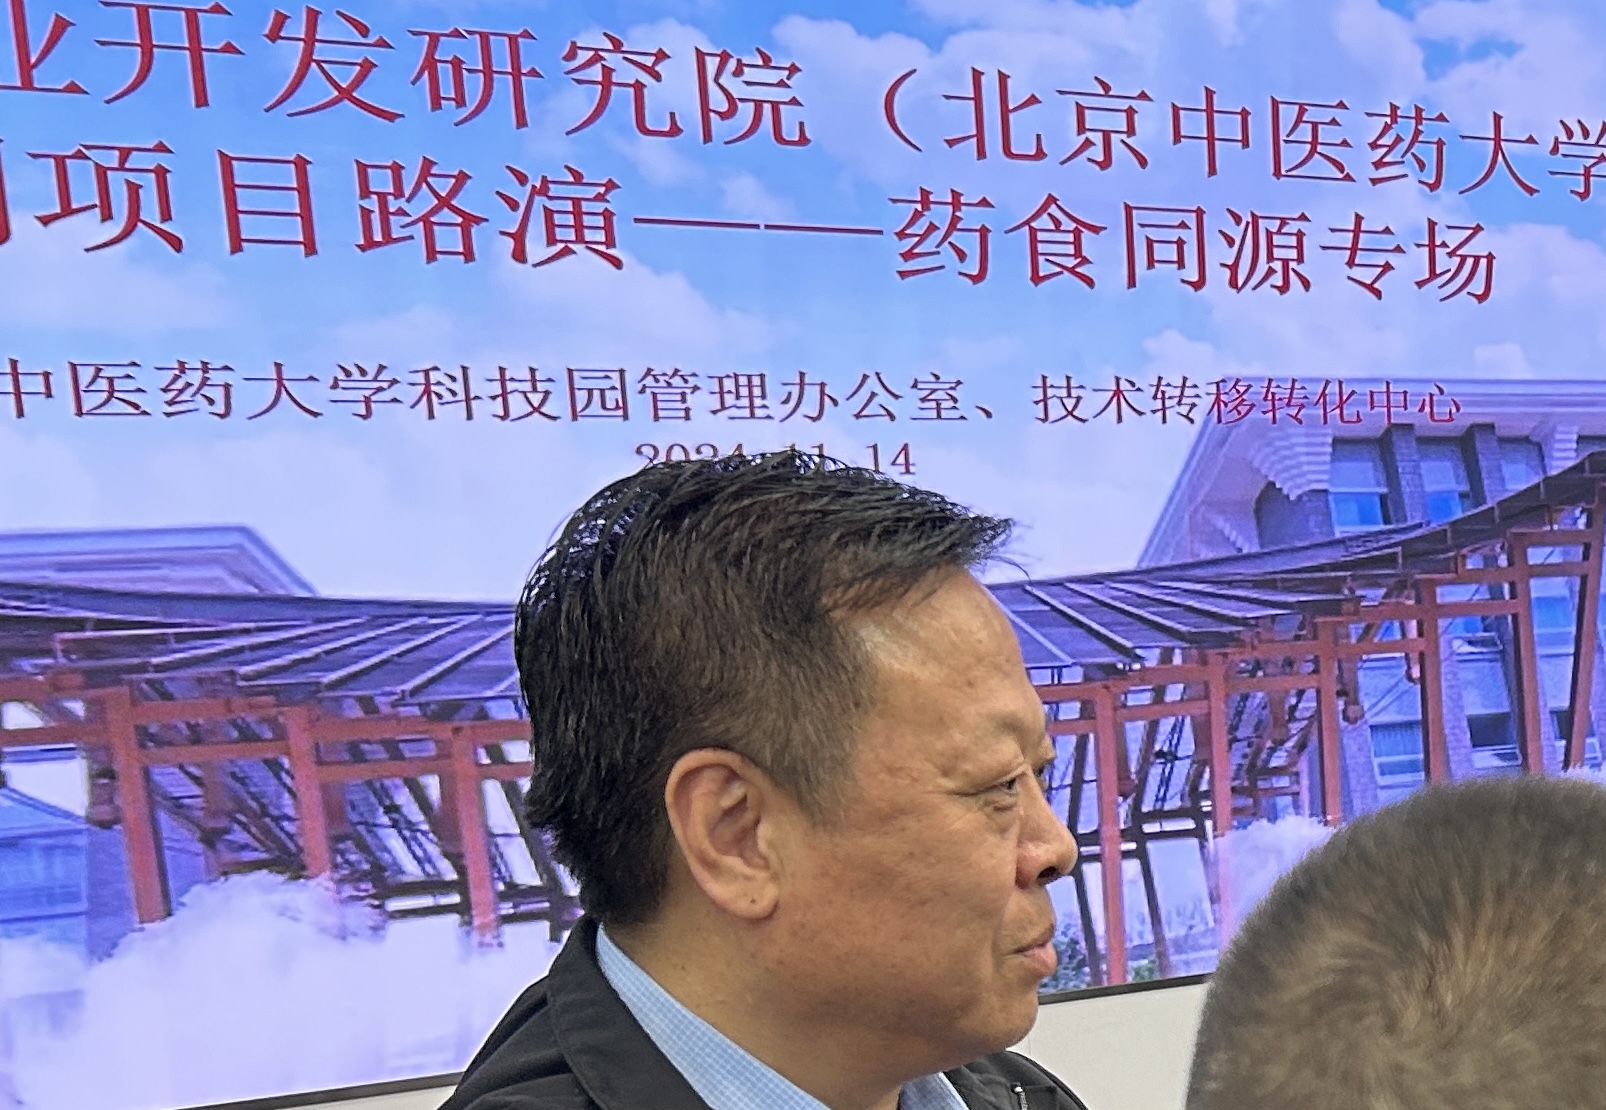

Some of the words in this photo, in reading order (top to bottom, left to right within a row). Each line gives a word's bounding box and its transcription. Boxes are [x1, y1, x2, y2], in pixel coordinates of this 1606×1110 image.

[0, 137, 1498, 306] 项目路演——药食同源专场
